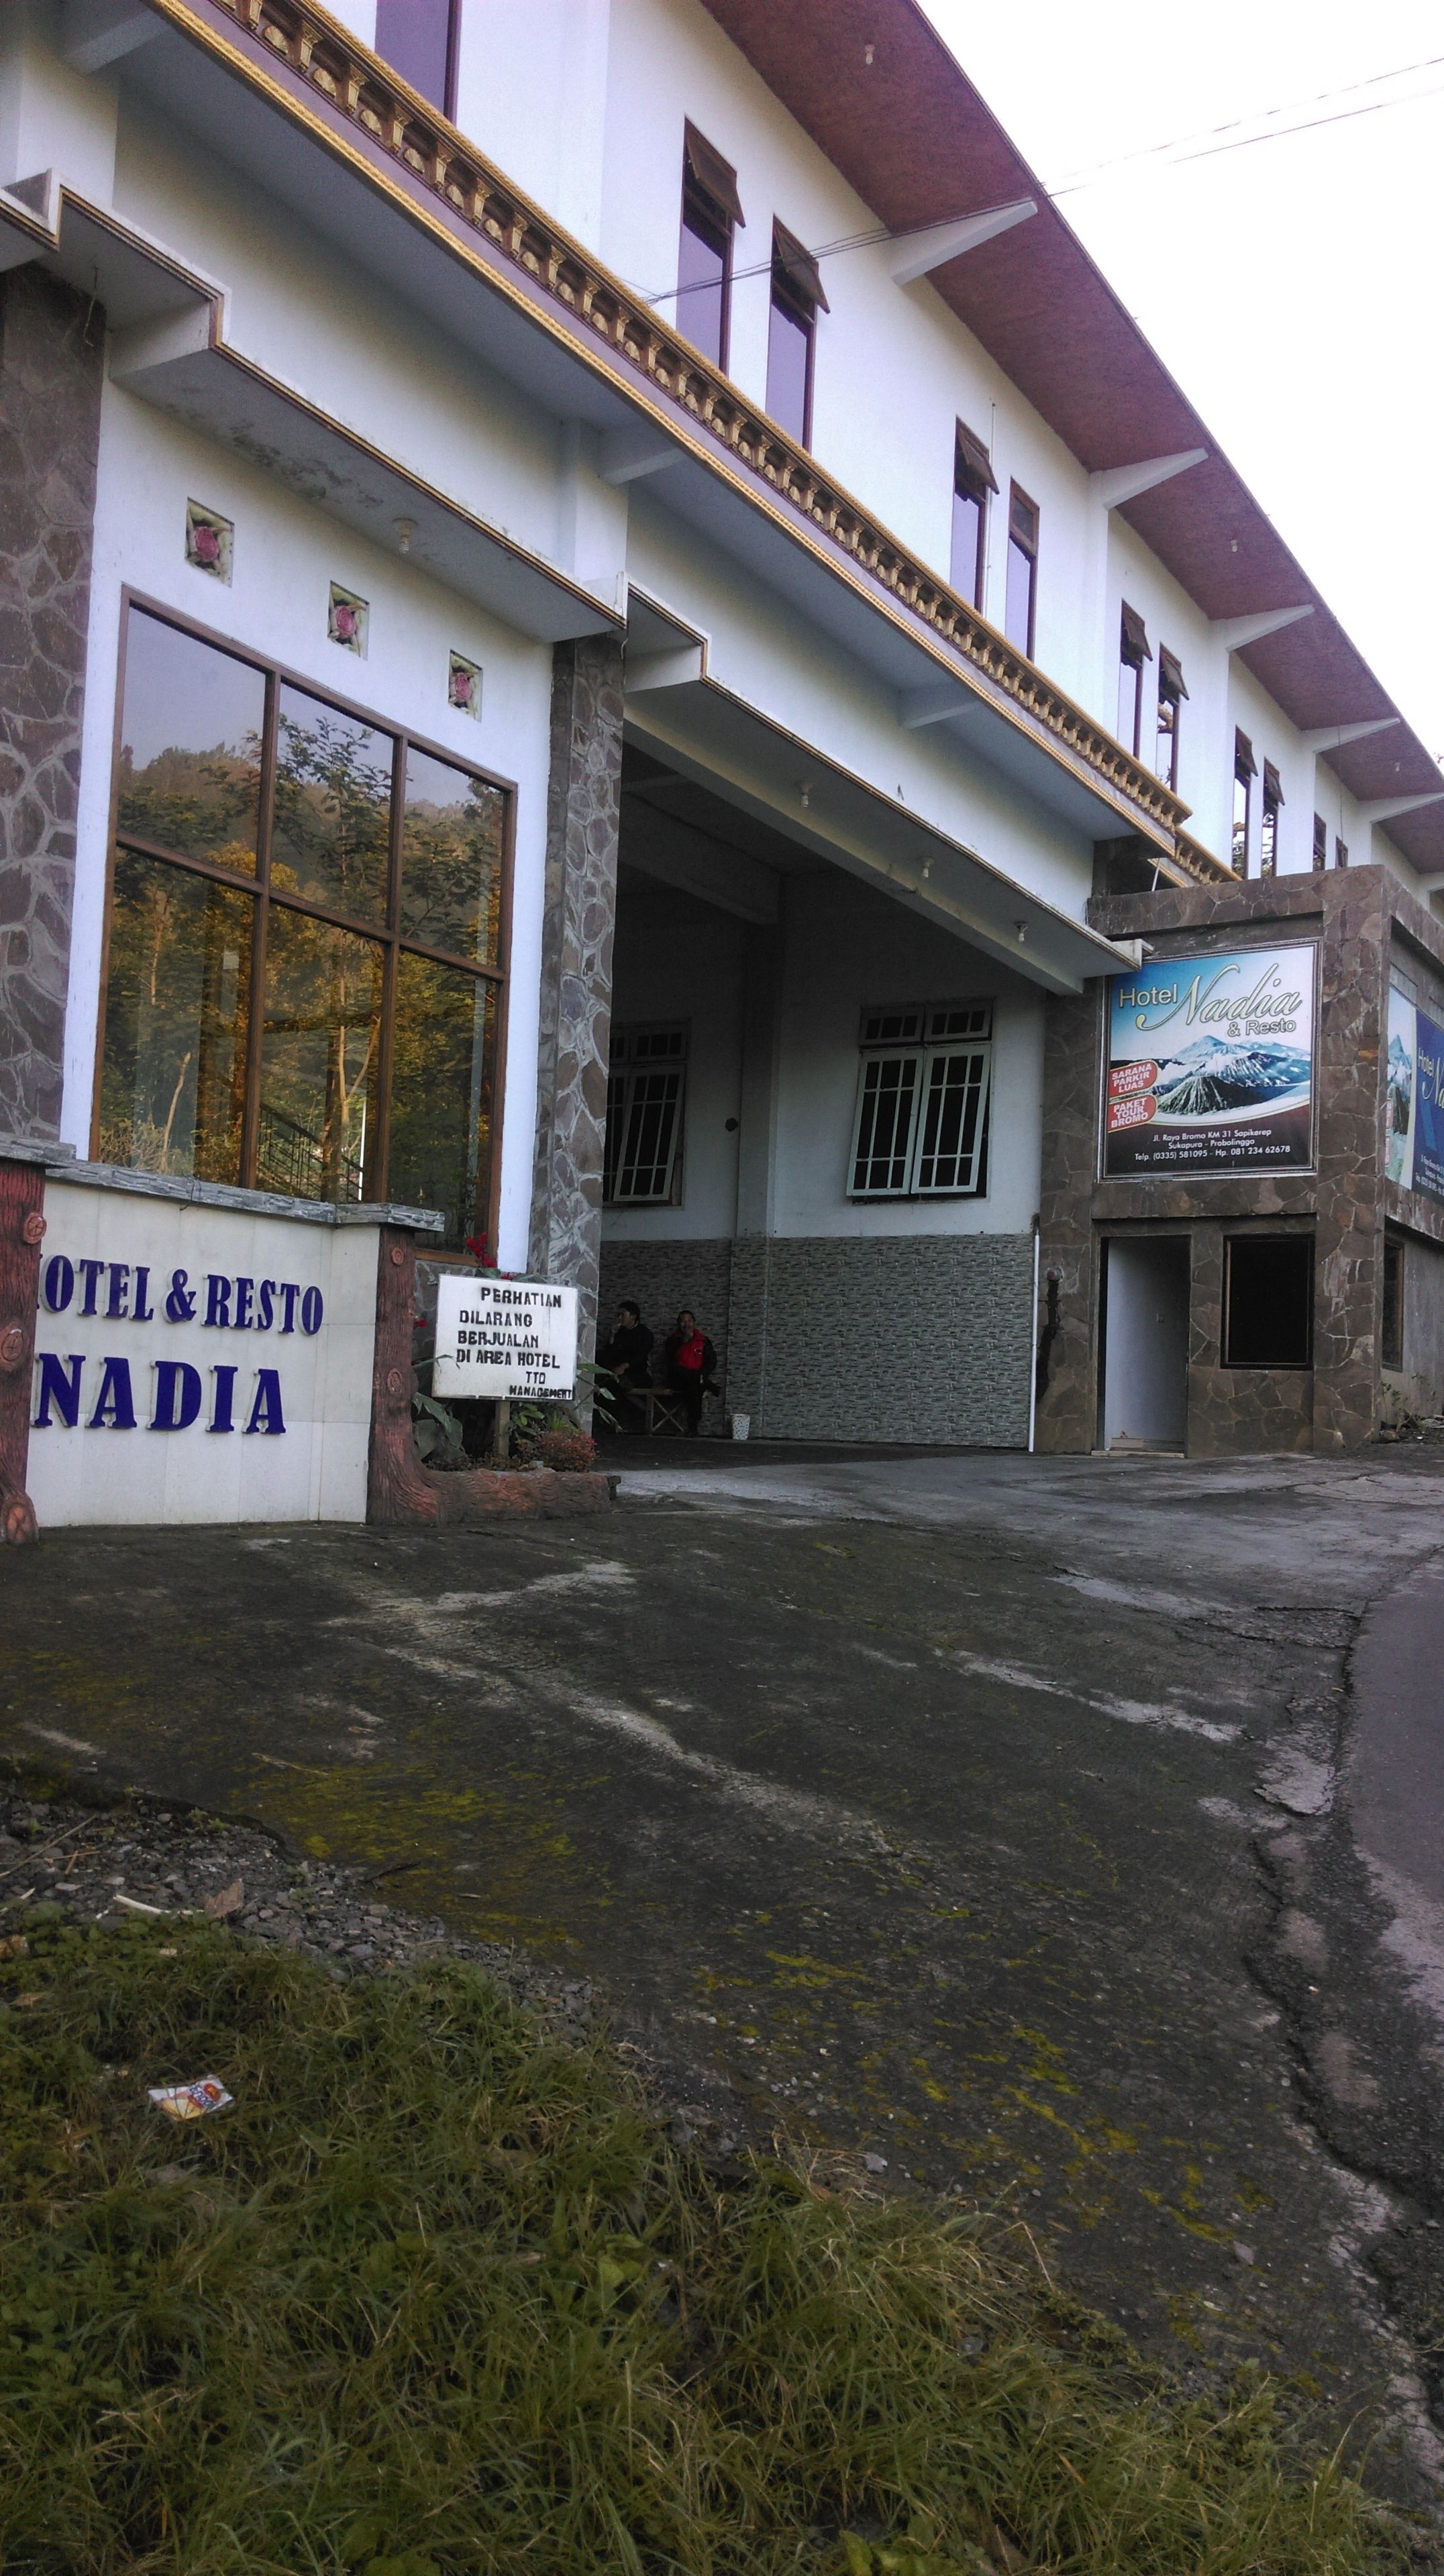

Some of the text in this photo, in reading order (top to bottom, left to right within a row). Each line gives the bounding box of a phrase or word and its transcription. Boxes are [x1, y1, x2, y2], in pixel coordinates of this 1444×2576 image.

[1119, 963, 1302, 1030] Hotel Nadia
[1227, 1018, 1296, 1037] & Resto
[1112, 1063, 1152, 1080] SARANA
[1114, 1071, 1149, 1087] PARKIR
[1119, 1080, 1144, 1093] LUAS
[1113, 1097, 1147, 1113] PAKET
[1116, 1106, 1144, 1119] TOUR
[1111, 1112, 1149, 1128] BROMO
[1234, 1129, 1272, 1137] Sapikerep
[1168, 1141, 1202, 1150] Sukapura
[1210, 1138, 1255, 1146] Probolinggo
[1153, 1151, 1177, 1161] (0335)
[1179, 1150, 1208, 1159] 581095
[1265, 1145, 1290, 1153] 62678
[36, 1253, 154, 1320] OTEL
[203, 1274, 323, 1336] RESTO
[481, 1287, 562, 1308] PERHATIAN
[460, 1309, 533, 1328] DILARANG
[458, 1330, 538, 1348] BERJUALAN
[456, 1349, 560, 1368] DI AREA HOTEL
[526, 1371, 546, 1385] TTD
[34, 1352, 287, 1434] NADIA
[509, 1385, 572, 1399] MANAGEMENT
